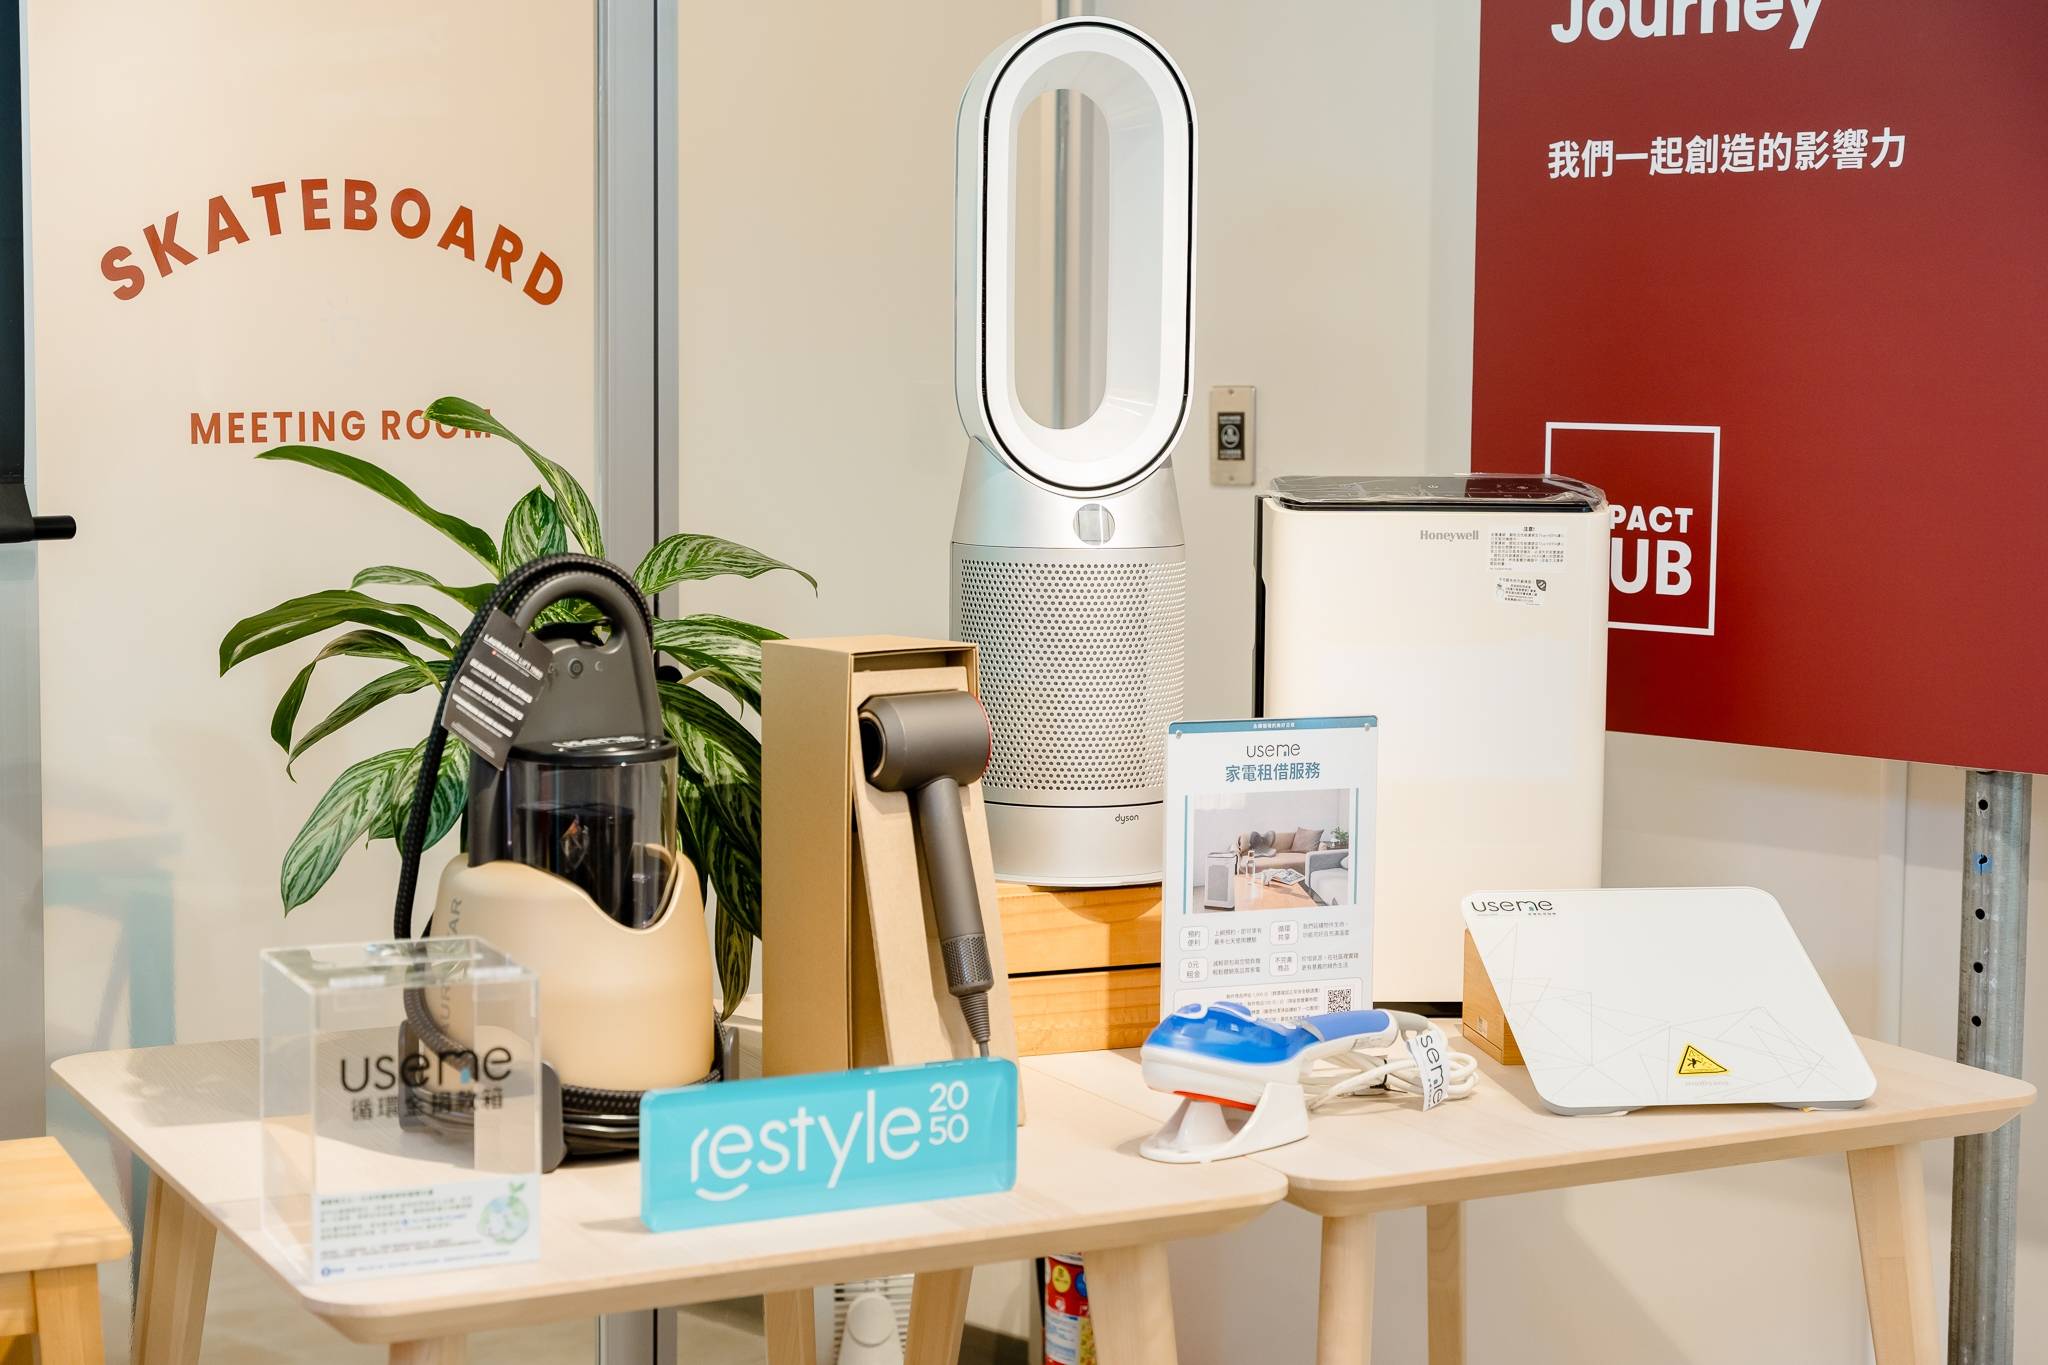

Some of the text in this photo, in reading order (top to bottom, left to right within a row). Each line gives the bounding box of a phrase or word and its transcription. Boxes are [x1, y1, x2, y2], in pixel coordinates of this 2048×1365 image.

[1551, 0, 1822, 49] Journey
[1548, 127, 1906, 180] 我們一起創造的影響力
[100, 178, 564, 306] SKATEBOARD
[190, 409, 491, 445] MEETING RO
[1420, 529, 1479, 542] Honeywell
[1246, 742, 1301, 758] useme
[1225, 761, 1321, 782] 家電租借服務
[1114, 813, 1139, 824] dyson
[1471, 900, 1553, 912] useme
[340, 1046, 512, 1093] useme
[690, 1080, 969, 1190] restyle 20
[928, 1113, 969, 1146] 50
